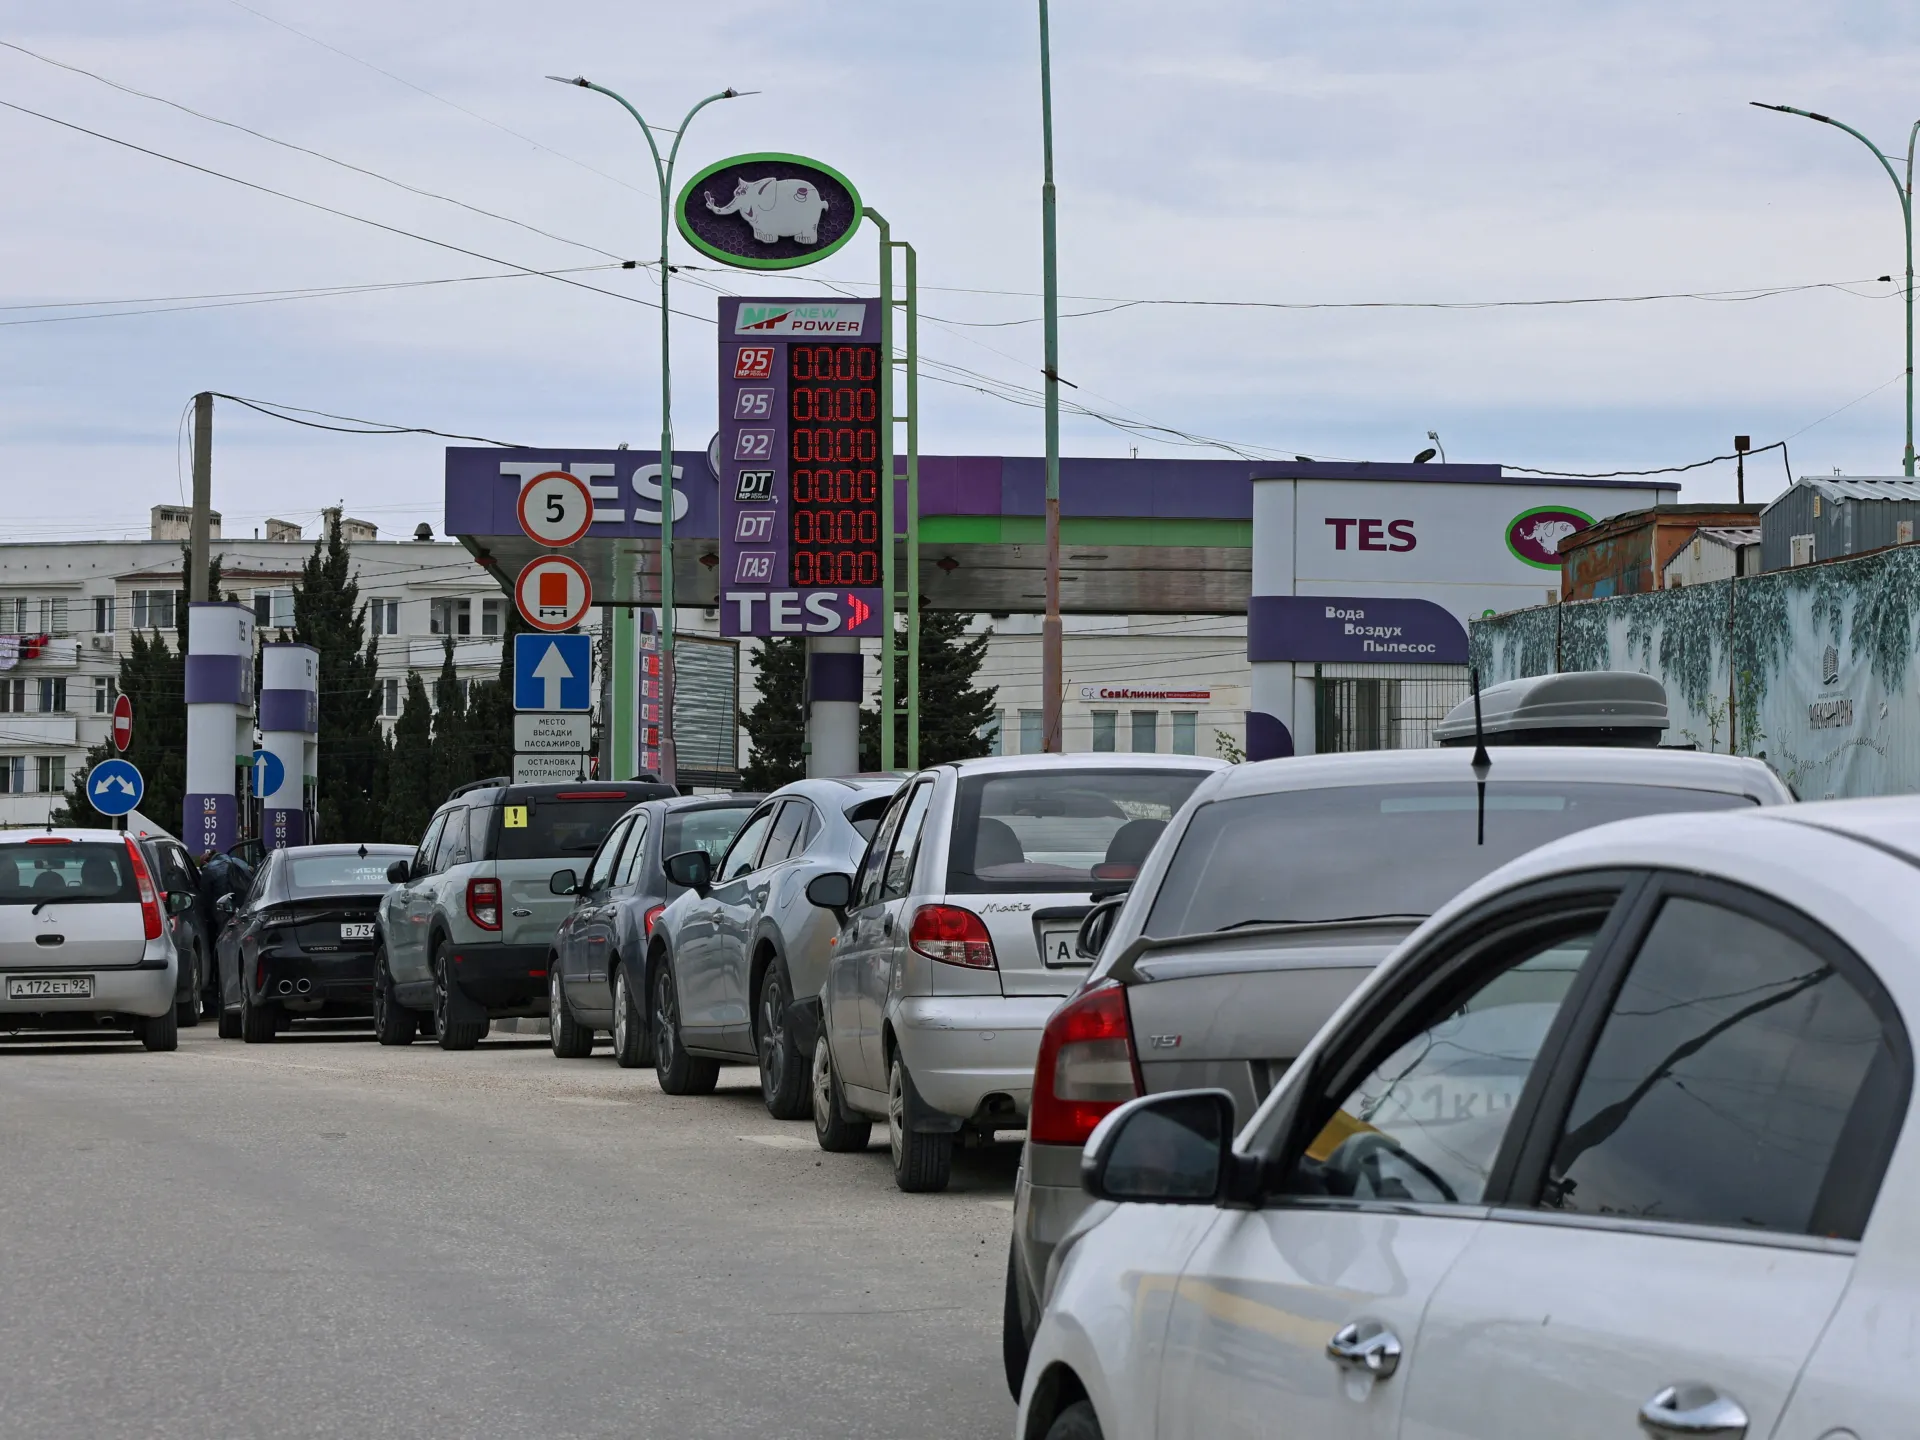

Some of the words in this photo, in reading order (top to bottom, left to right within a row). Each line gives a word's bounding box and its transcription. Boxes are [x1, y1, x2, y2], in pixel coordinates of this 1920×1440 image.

[794, 308, 840, 319] NEW
[791, 321, 860, 332] POWER
[741, 350, 769, 370] 95
[741, 394, 768, 414] 95
[741, 434, 769, 455] 92
[740, 472, 772, 492] DT
[545, 494, 565, 523] 5
[740, 517, 771, 536] DT
[1325, 518, 1417, 553] TES
[742, 557, 769, 578] ГАЗ
[725, 591, 842, 633] TES
[1325, 606, 1365, 621] Вода
[1344, 623, 1402, 638] Воздух
[1363, 640, 1436, 653] Пылесос
[1100, 688, 1167, 700] СевКлиник
[538, 718, 566, 726] МЕСТО
[533, 729, 573, 737] ВЫСАДКИ
[524, 740, 581, 748] ПАССАЖИРОВ
[527, 758, 576, 766] ОСТАНОВКА
[204, 798, 216, 811] 95
[204, 816, 217, 829] 95
[276, 812, 287, 823] 95
[204, 832, 217, 845] 92
[275, 827, 287, 838] 95
[979, 903, 1031, 914] Matiz
